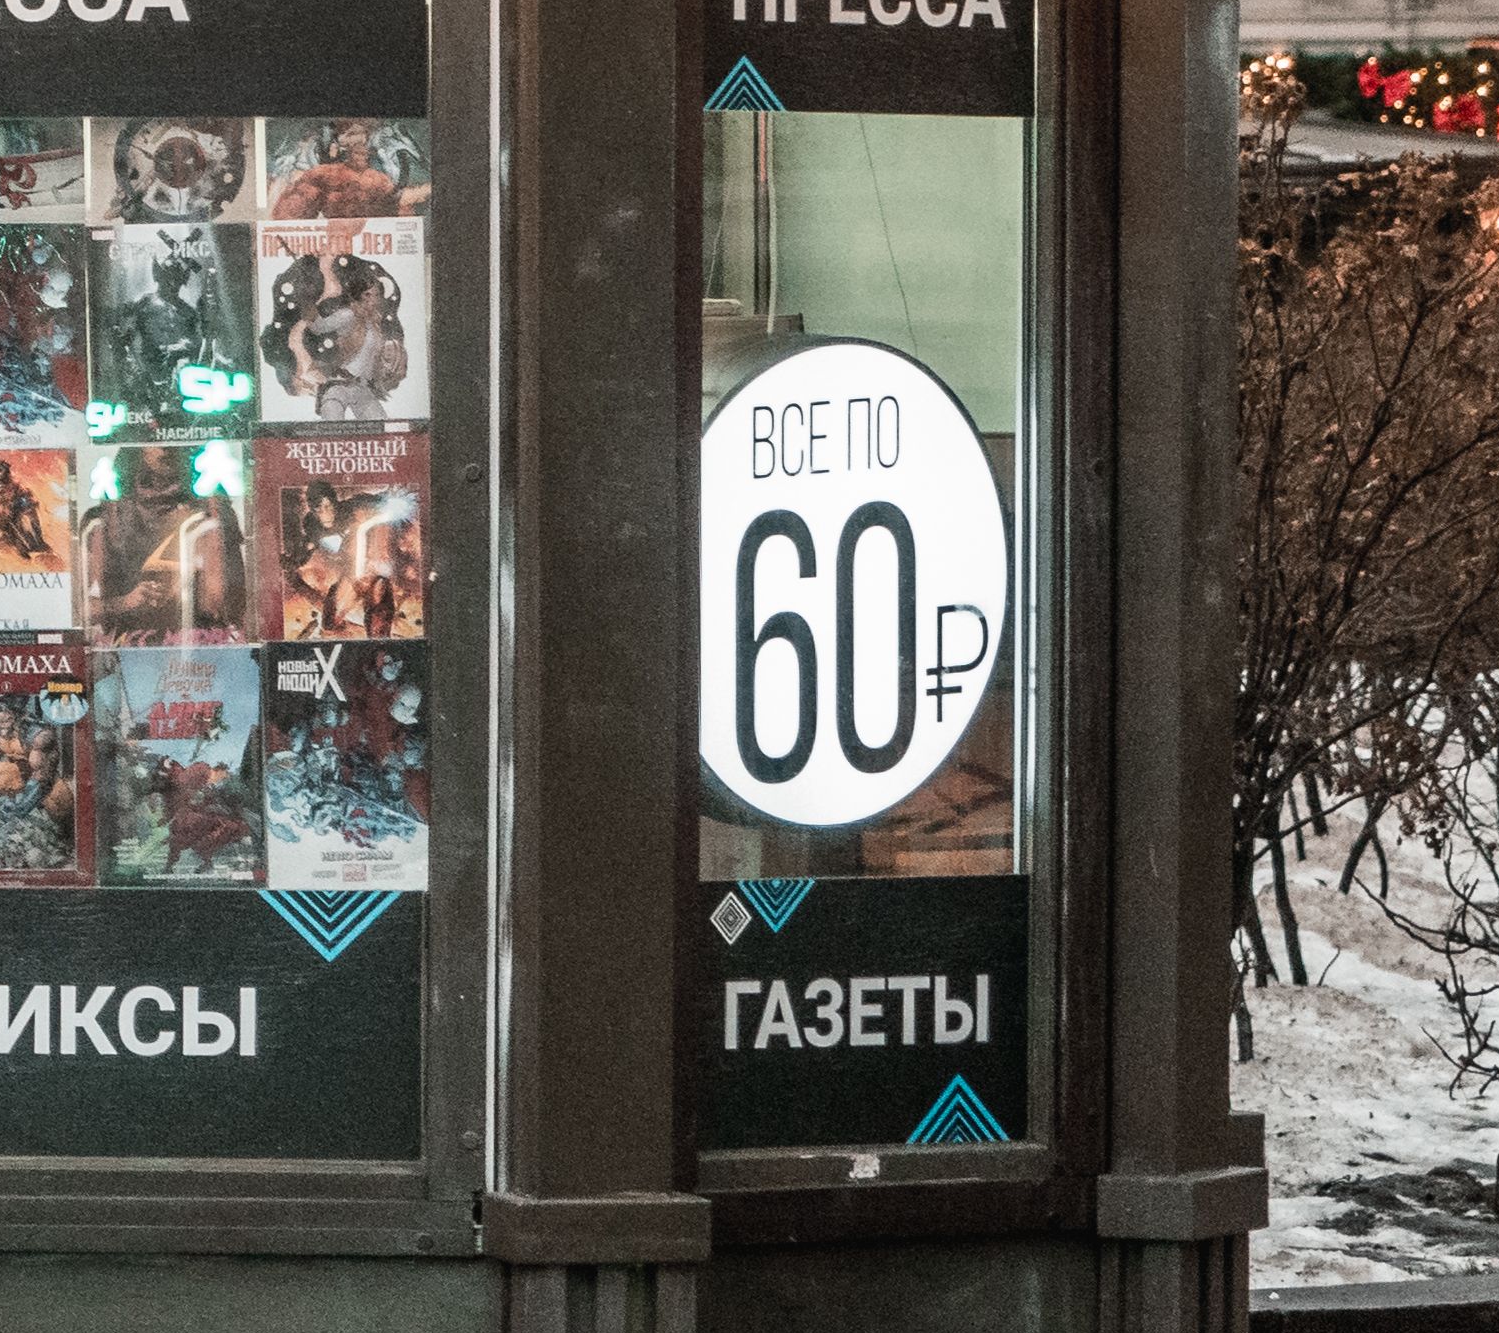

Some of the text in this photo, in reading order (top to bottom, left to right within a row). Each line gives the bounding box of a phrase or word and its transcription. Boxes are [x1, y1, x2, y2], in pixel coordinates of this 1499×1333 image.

[752, 391, 902, 481] ВСЕ ПО
[285, 436, 408, 459] ЖЕЛЕЗНЫЙ
[300, 456, 397, 475] ЧЕЛОВЕК
[277, 660, 320, 673] НОВЫЕ
[277, 673, 320, 693] ЛЮДИ
[721, 973, 992, 1054] ГАЗЕТЫ
